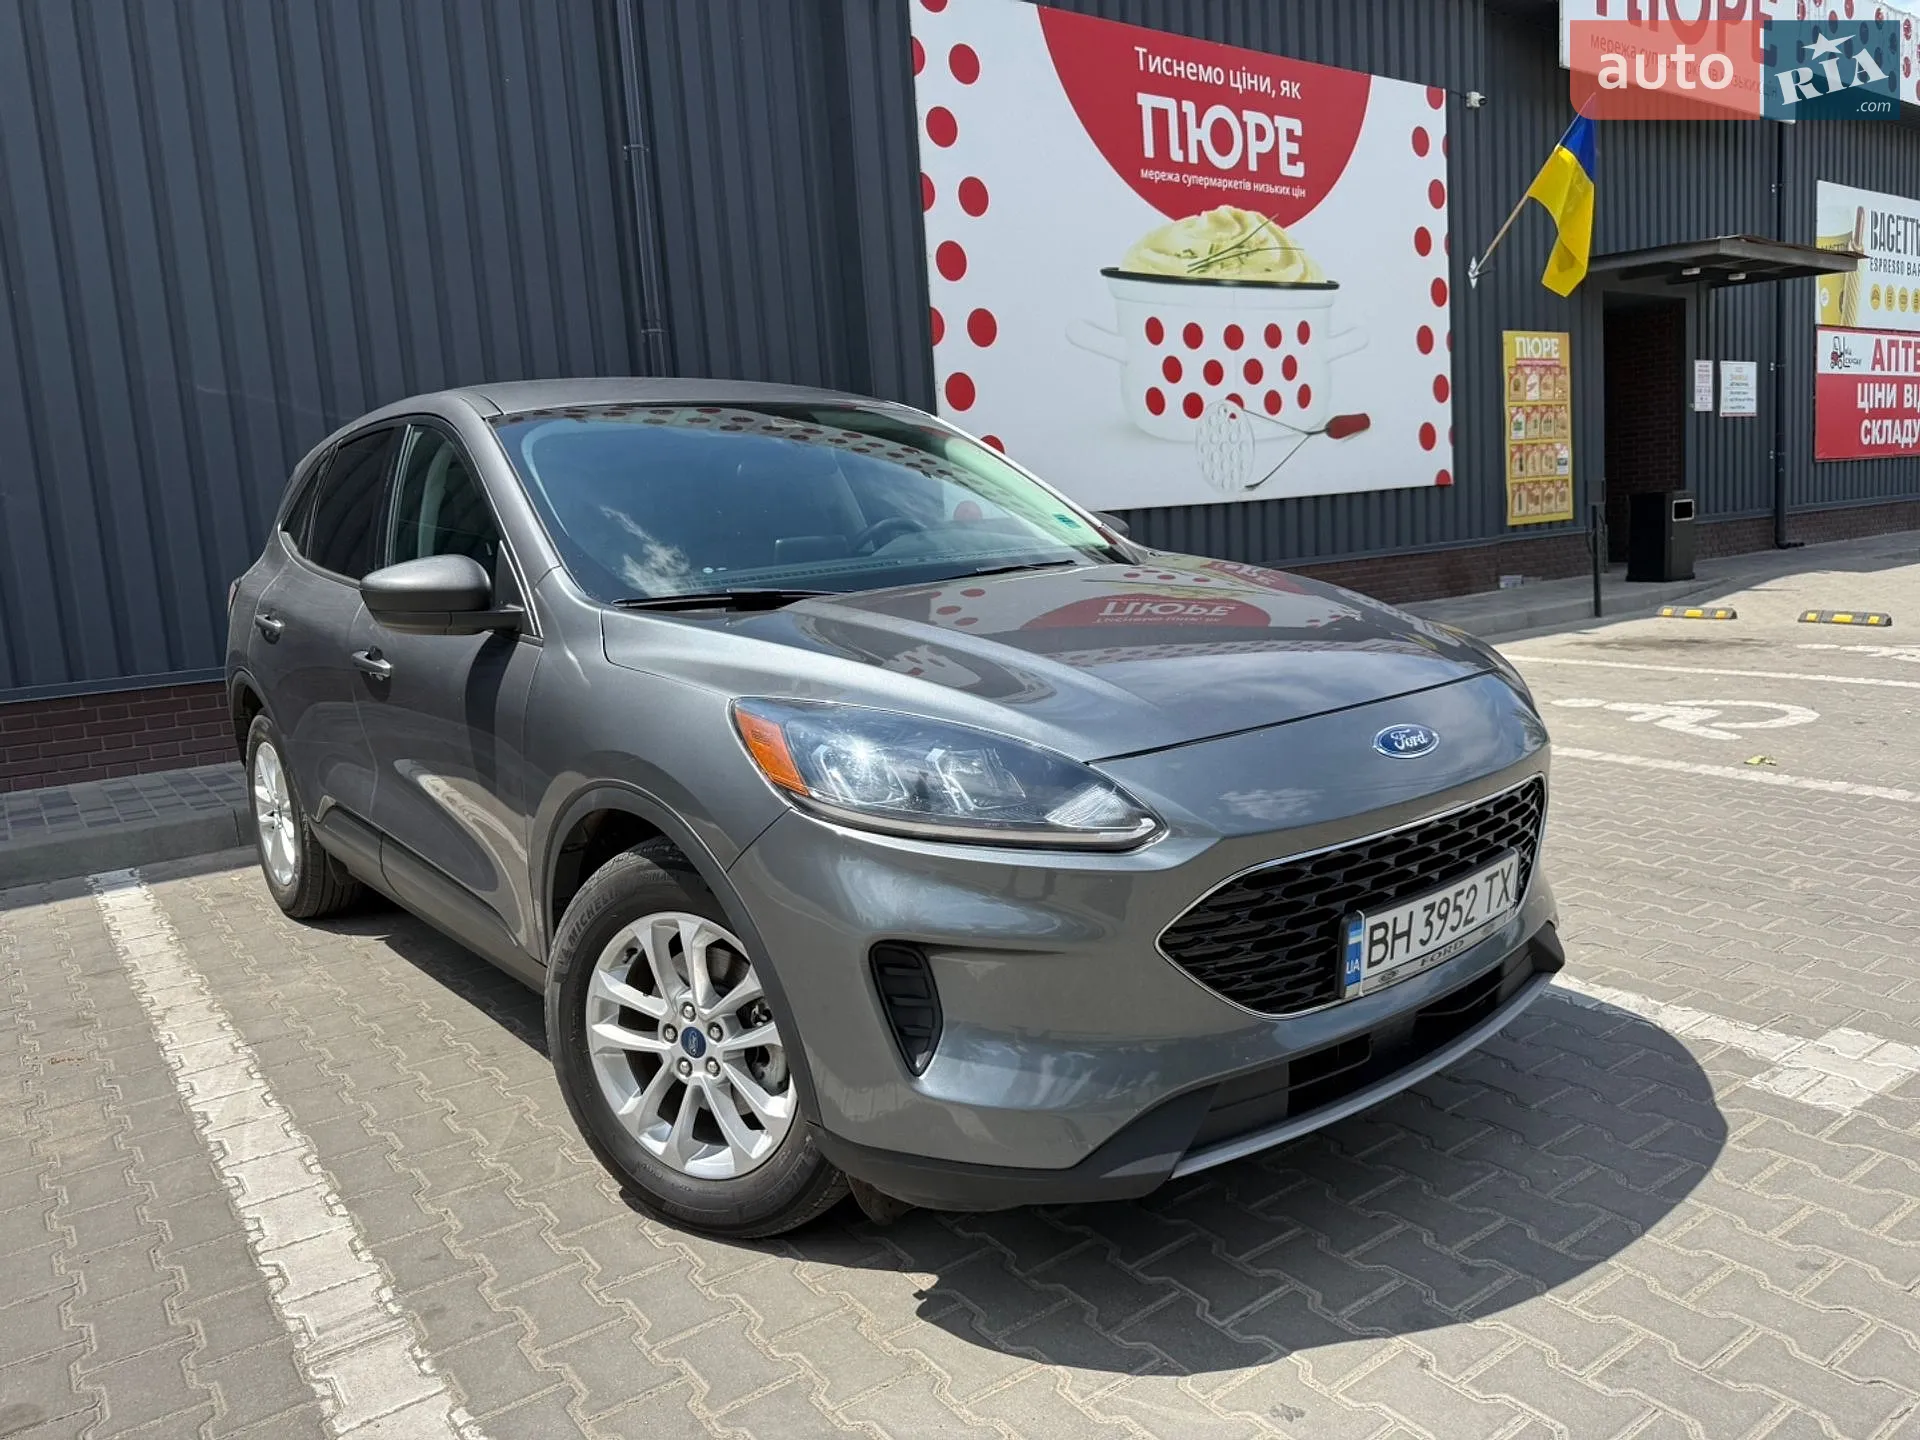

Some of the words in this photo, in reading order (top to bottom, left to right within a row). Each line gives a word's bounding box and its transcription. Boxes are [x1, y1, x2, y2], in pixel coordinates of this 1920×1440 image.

[1134, 46, 1225, 85] Тиснемо
[1229, 66, 1276, 98] ціни,
[1280, 80, 1302, 99] як
[1136, 91, 1305, 178] ПЮРЕ
[1140, 168, 1180, 183] мережа
[1181, 174, 1251, 191] супермаркетів
[1253, 182, 1291, 196] низьких
[1291, 187, 1306, 198] цін
[1870, 257, 1904, 275] ESPRESSO
[1515, 336, 1560, 359] ПЮРЕ
[1857, 382, 1897, 414] ЦІНИ
[1861, 418, 1920, 449] СКЛАДУ
[1390, 729, 1429, 751] Ford
[1346, 959, 1361, 975] UA
[1366, 910, 1415, 970] BH
[1418, 883, 1478, 947] 3952
[1484, 862, 1514, 914] TX
[1420, 939, 1465, 967] FORD
